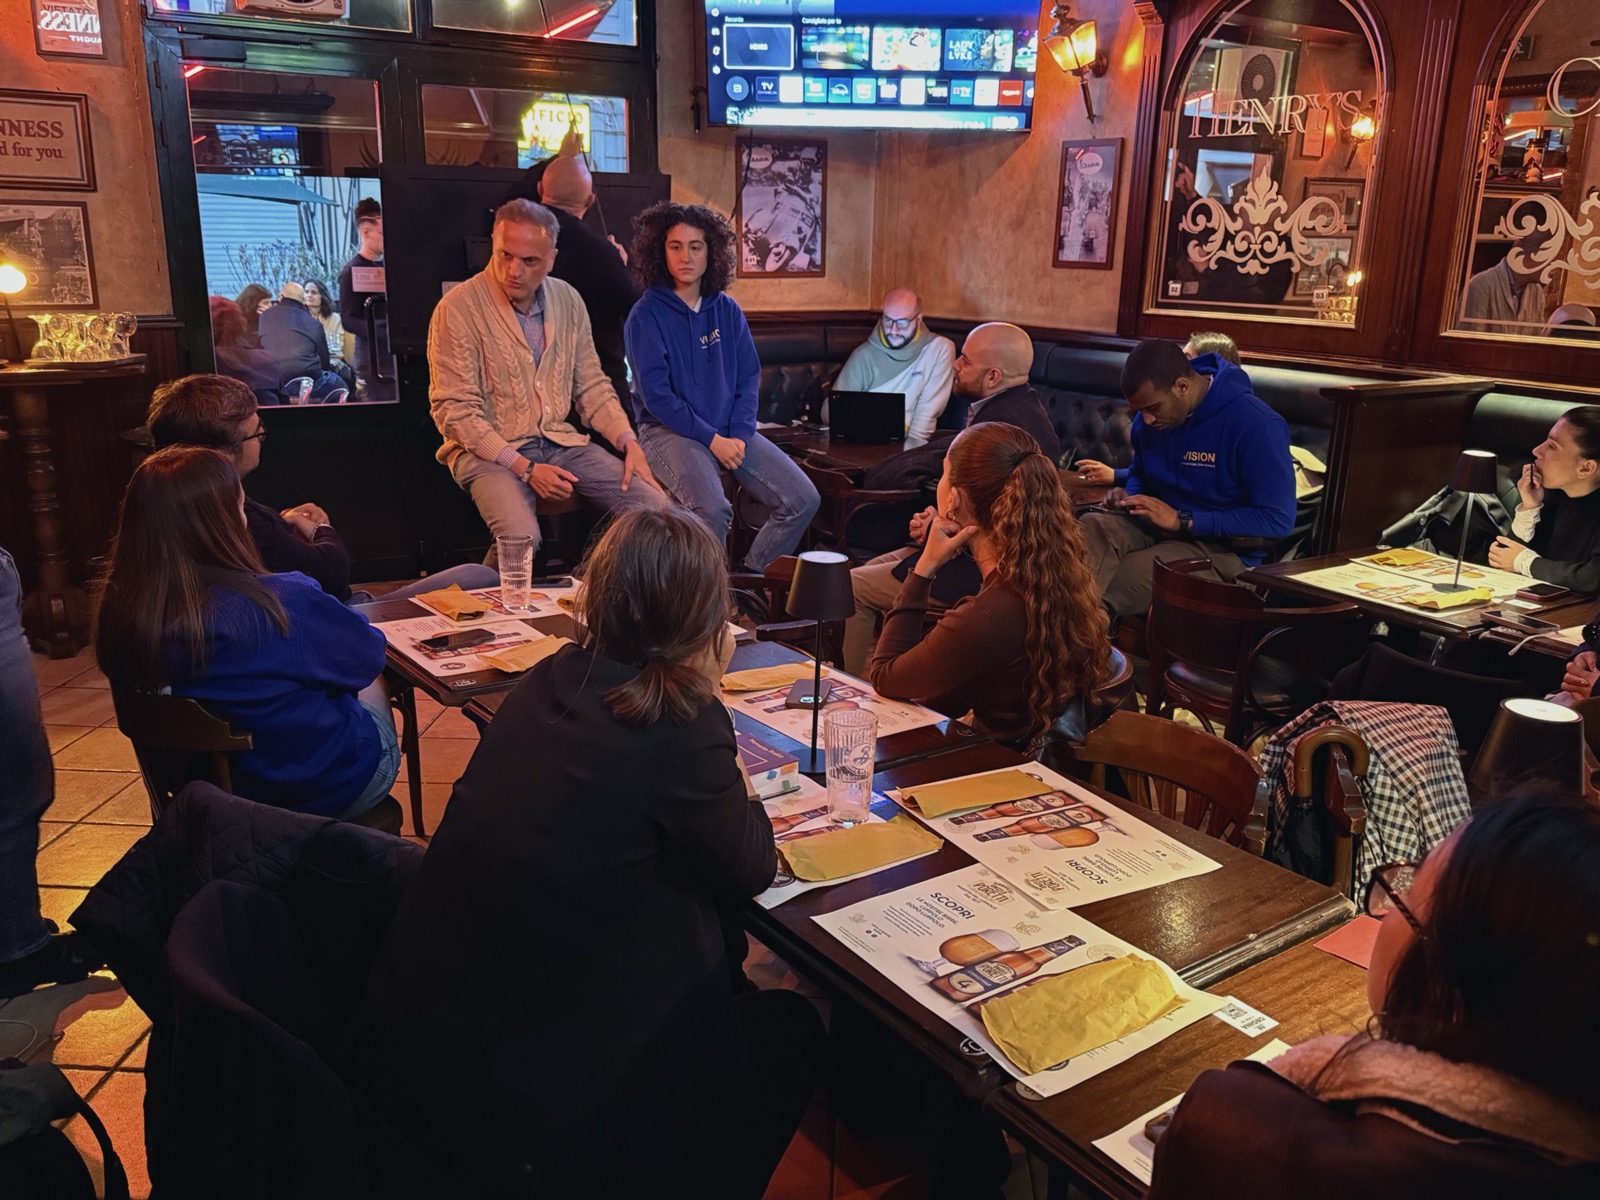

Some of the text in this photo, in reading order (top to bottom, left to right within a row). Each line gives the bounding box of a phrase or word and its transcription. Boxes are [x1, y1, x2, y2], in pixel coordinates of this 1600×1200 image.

[1188, 89, 1362, 138] HENRY'S
[12, 142, 33, 157] for
[1183, 451, 1216, 463] VISION
[1065, 859, 1108, 885] SCOPRI
[972, 882, 1008, 903] PORETTI
[930, 892, 975, 920] SCOPRI
[956, 978, 971, 989] 4
